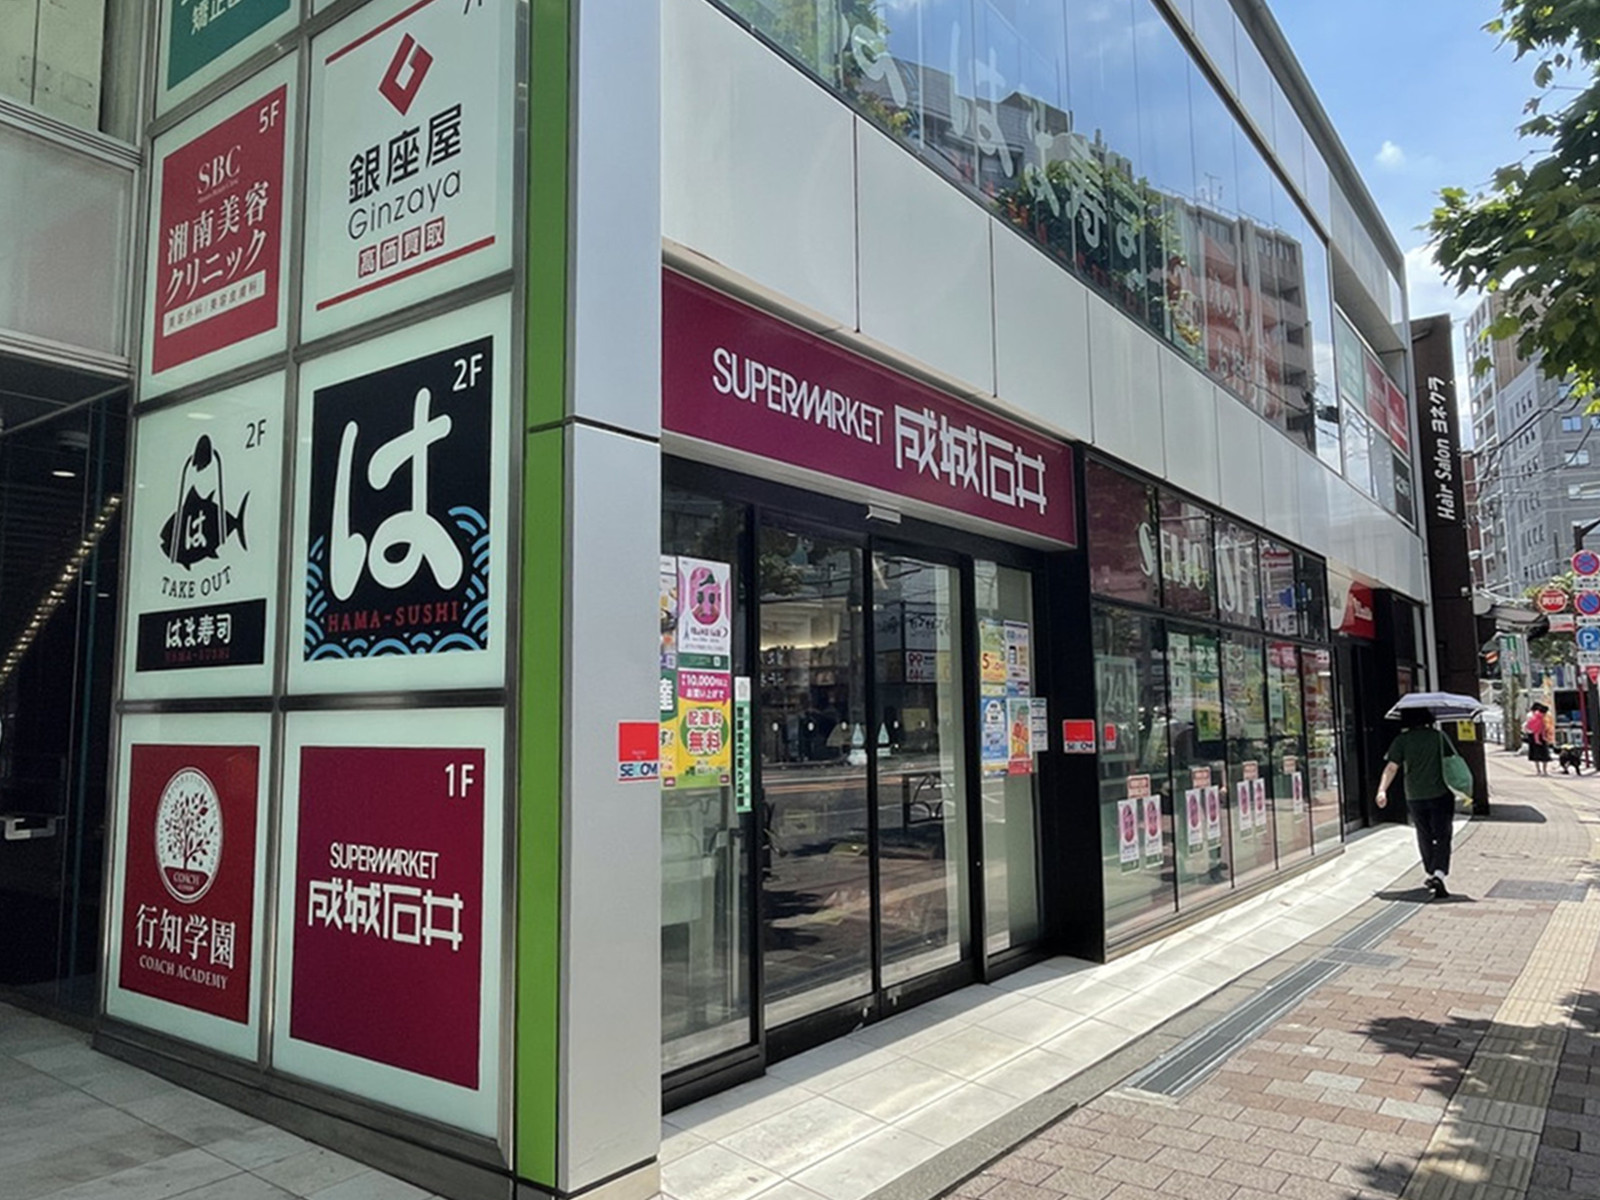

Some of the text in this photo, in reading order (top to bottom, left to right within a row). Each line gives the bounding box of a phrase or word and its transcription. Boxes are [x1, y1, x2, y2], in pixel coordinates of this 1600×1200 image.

[258, 100, 280, 134] 5F
[197, 145, 241, 194] SBC
[348, 103, 462, 204] 銀座屋
[168, 180, 269, 265] 湘南美容
[348, 168, 462, 240] Ginzaya
[165, 228, 267, 307] クリニック
[358, 217, 445, 278] 高価買取
[452, 353, 484, 391] 2F
[245, 419, 268, 449] 2F
[712, 347, 1047, 515] SUPERMARKET 成城石井
[1434, 438, 1453, 481] Salon
[330, 386, 463, 600] は
[1437, 484, 1456, 521] Hair
[185, 511, 208, 551] は
[161, 565, 231, 599] TAKE OUT
[165, 613, 231, 648] はま寿司
[327, 601, 460, 633] HAMA-SUSHI
[444, 763, 475, 798] 1F
[329, 842, 439, 880] SUPERMARKET
[308, 878, 464, 951] 成城石井
[135, 903, 236, 970] 行知学園
[139, 954, 228, 990] COACH ACADEMY
